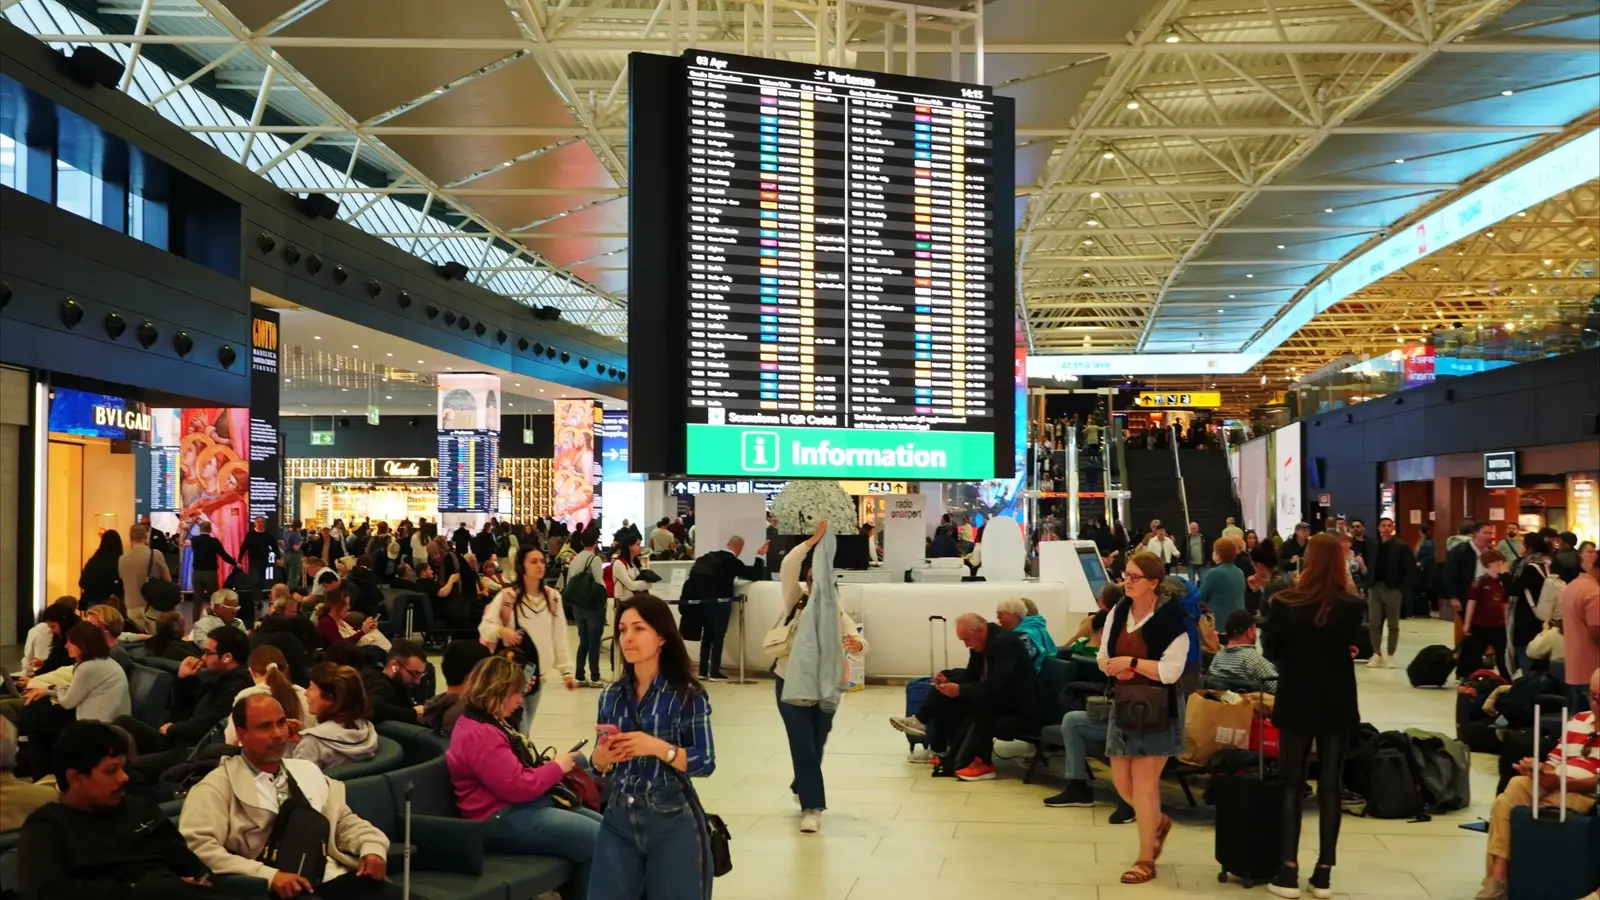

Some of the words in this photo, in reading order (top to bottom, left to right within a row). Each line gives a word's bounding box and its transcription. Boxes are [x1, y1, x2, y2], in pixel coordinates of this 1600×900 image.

[696, 56, 708, 66] 03
[710, 57, 728, 70] Apr
[828, 70, 876, 87] Partenze
[960, 88, 984, 99] 14:15
[789, 415, 806, 425] QR
[792, 440, 947, 468] Information
[895, 499, 913, 509] radio
